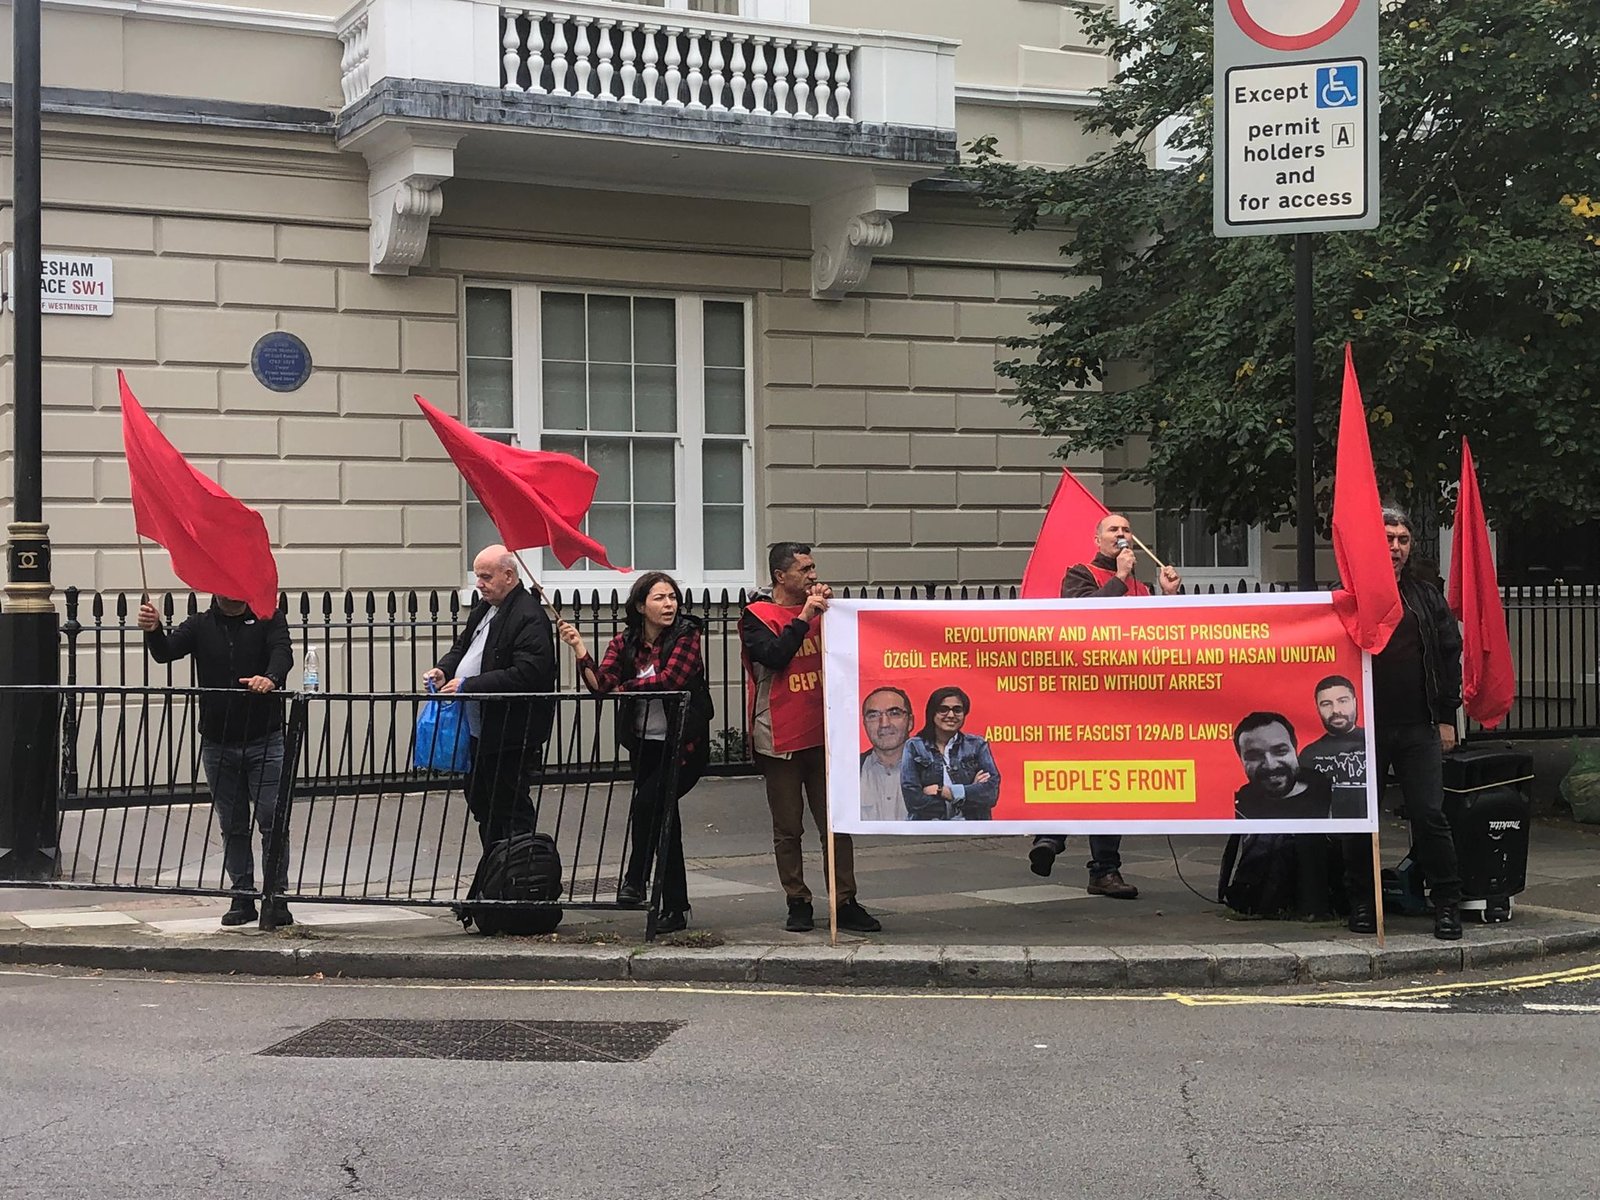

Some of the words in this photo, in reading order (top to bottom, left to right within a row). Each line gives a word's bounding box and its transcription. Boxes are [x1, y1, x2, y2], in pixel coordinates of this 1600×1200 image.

[1235, 82, 1308, 104] Except
[1249, 117, 1320, 142] permit
[1337, 126, 1350, 146] A
[1244, 143, 1325, 162] holders
[1276, 166, 1314, 184] and
[1239, 194, 1270, 210] for
[1278, 192, 1352, 208] access
[40, 261, 94, 277] ESHAM
[40, 279, 66, 294] ACE
[72, 280, 104, 296] SW1
[48, 302, 98, 312] WESTMINSTER
[945, 626, 1054, 643] REVOLUTIONARY
[1058, 626, 1086, 642] AND
[1091, 624, 1186, 642] ANTI-FASCIST
[1190, 623, 1270, 640] PRISONERS
[884, 650, 926, 668] ÖZGÜL
[931, 652, 972, 669] EMRE,
[976, 648, 1017, 668] İHSAN
[1082, 649, 1138, 666] SERKAN
[1142, 646, 1192, 666] KÜPELI
[1196, 648, 1224, 665] AND
[1230, 647, 1276, 664] HASAN
[1280, 646, 1336, 663] UNUTAN
[997, 676, 1038, 692] MUST
[1040, 675, 1056, 692] BE
[1060, 674, 1099, 692] TRIED
[1104, 674, 1166, 691] WITHOUT
[1169, 673, 1223, 690] ARREST
[984, 725, 1043, 742] ABOLISH
[1048, 725, 1072, 742] THE
[1076, 724, 1132, 742] FASCIST
[1136, 724, 1184, 741] 129A/B
[1189, 724, 1233, 741] LAWS!
[1127, 768, 1187, 790] FRONT
